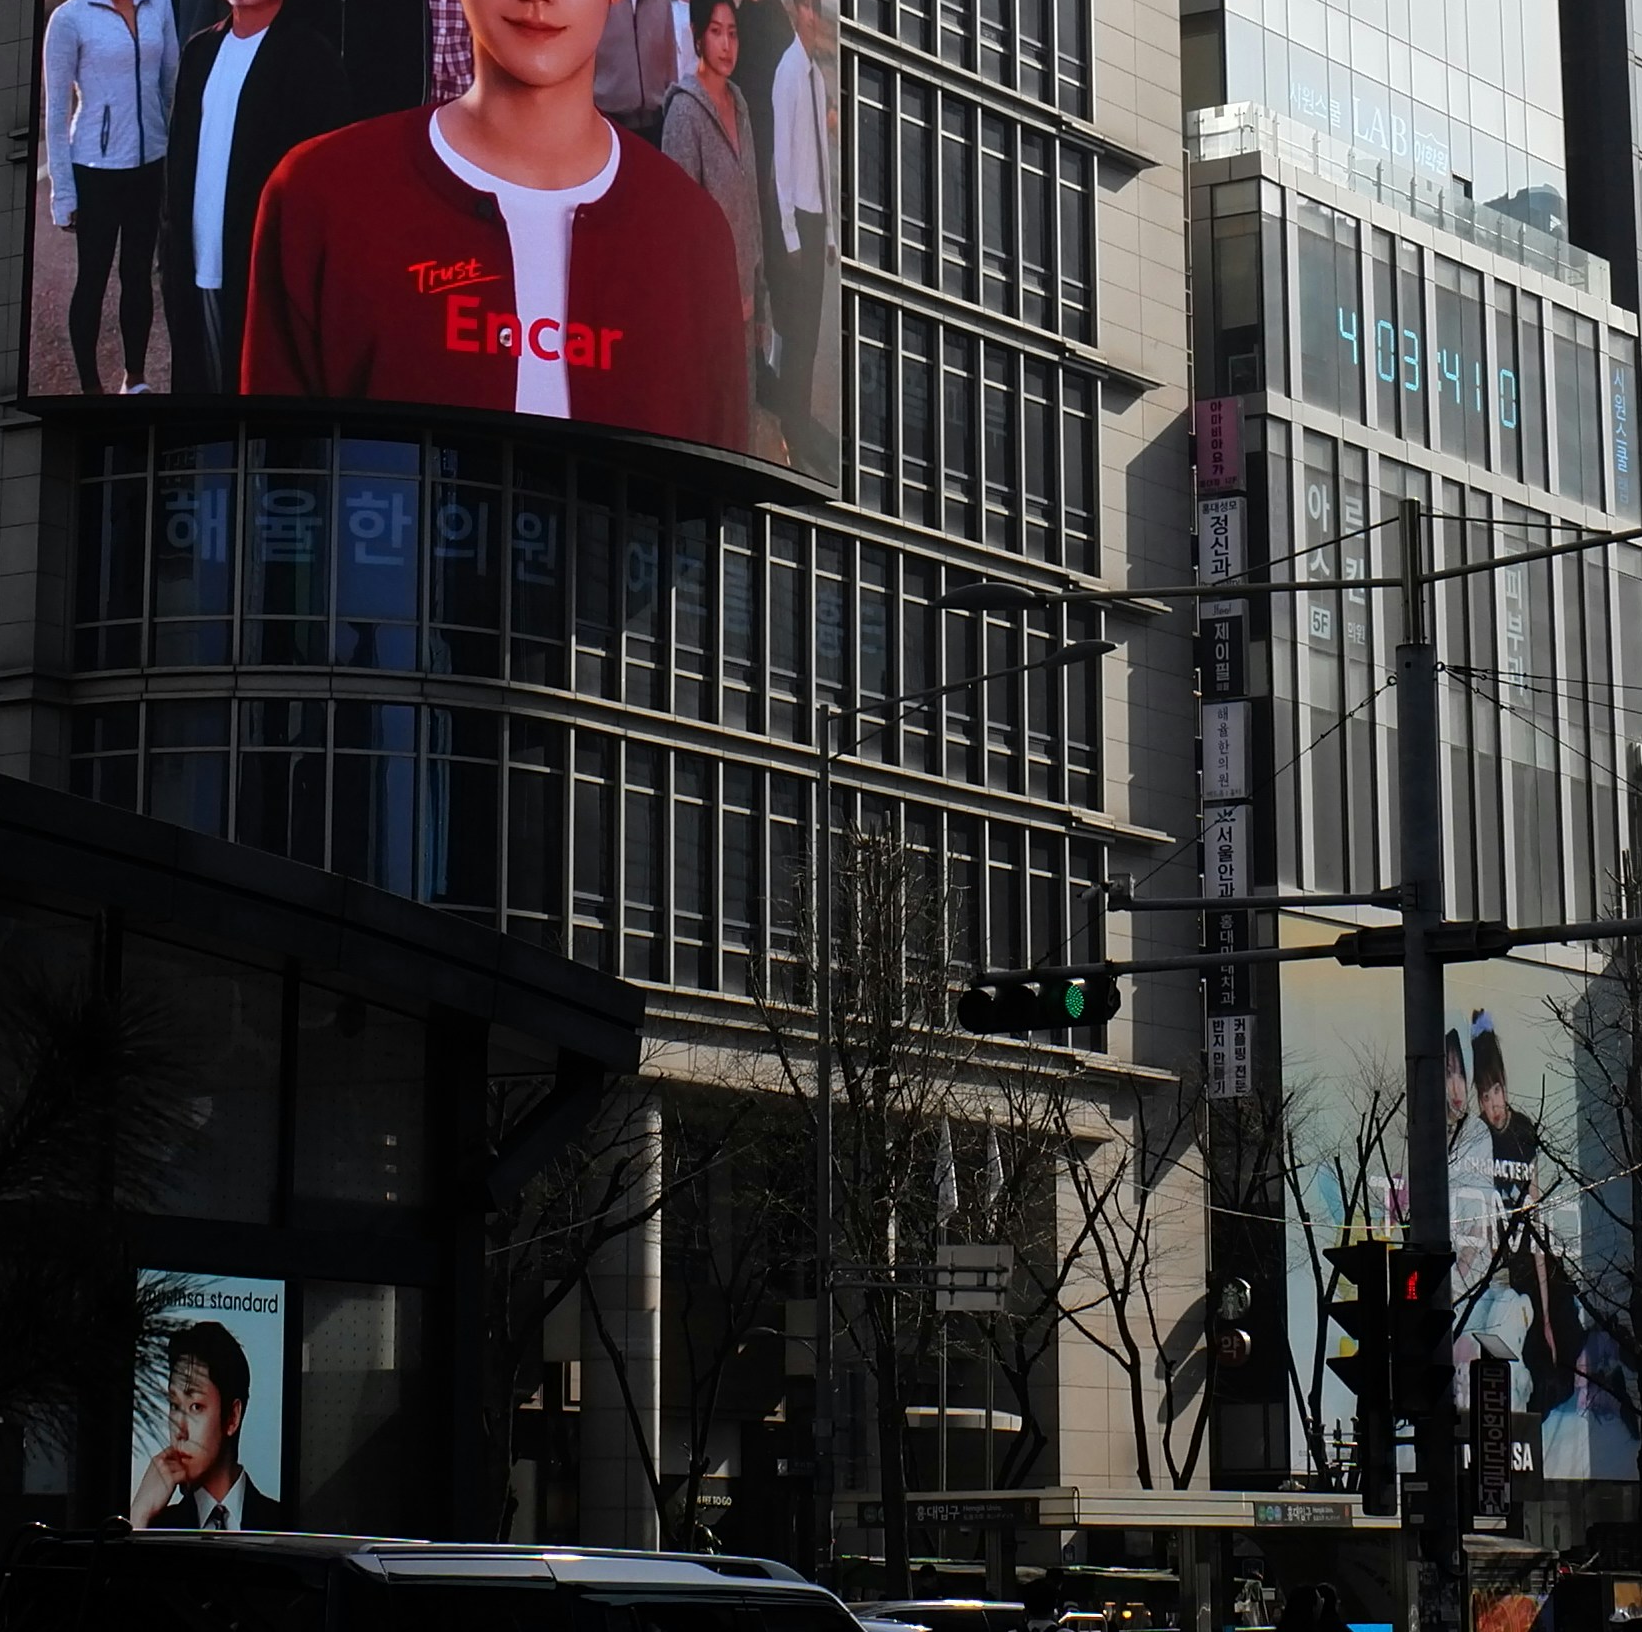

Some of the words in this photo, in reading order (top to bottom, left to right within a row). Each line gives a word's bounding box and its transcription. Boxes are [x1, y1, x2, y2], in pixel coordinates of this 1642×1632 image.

[1290, 82, 1342, 128] 시원스쿨
[1352, 95, 1407, 157] LAB
[1415, 140, 1449, 176] 어학원
[408, 258, 483, 293] Trust
[446, 294, 623, 370] Encar
[1210, 400, 1224, 475] 아마비아요가
[1202, 501, 1237, 514] 홍대성모
[161, 487, 557, 587] 해율한의원
[1210, 514, 1231, 576] 정신과
[1313, 611, 1329, 633] 5F
[1347, 622, 1366, 646] 의원
[1215, 621, 1230, 681] 제이필
[1218, 706, 1230, 788] 해율한의원
[1218, 827, 1234, 897] 서울안과
[1213, 1020, 1224, 1047] 반지
[209, 1292, 279, 1314] standard
[1221, 1335, 1239, 1359] 약
[1482, 1368, 1507, 1511] 무단횡단금지
[916, 1505, 960, 1521] 홍대입구
